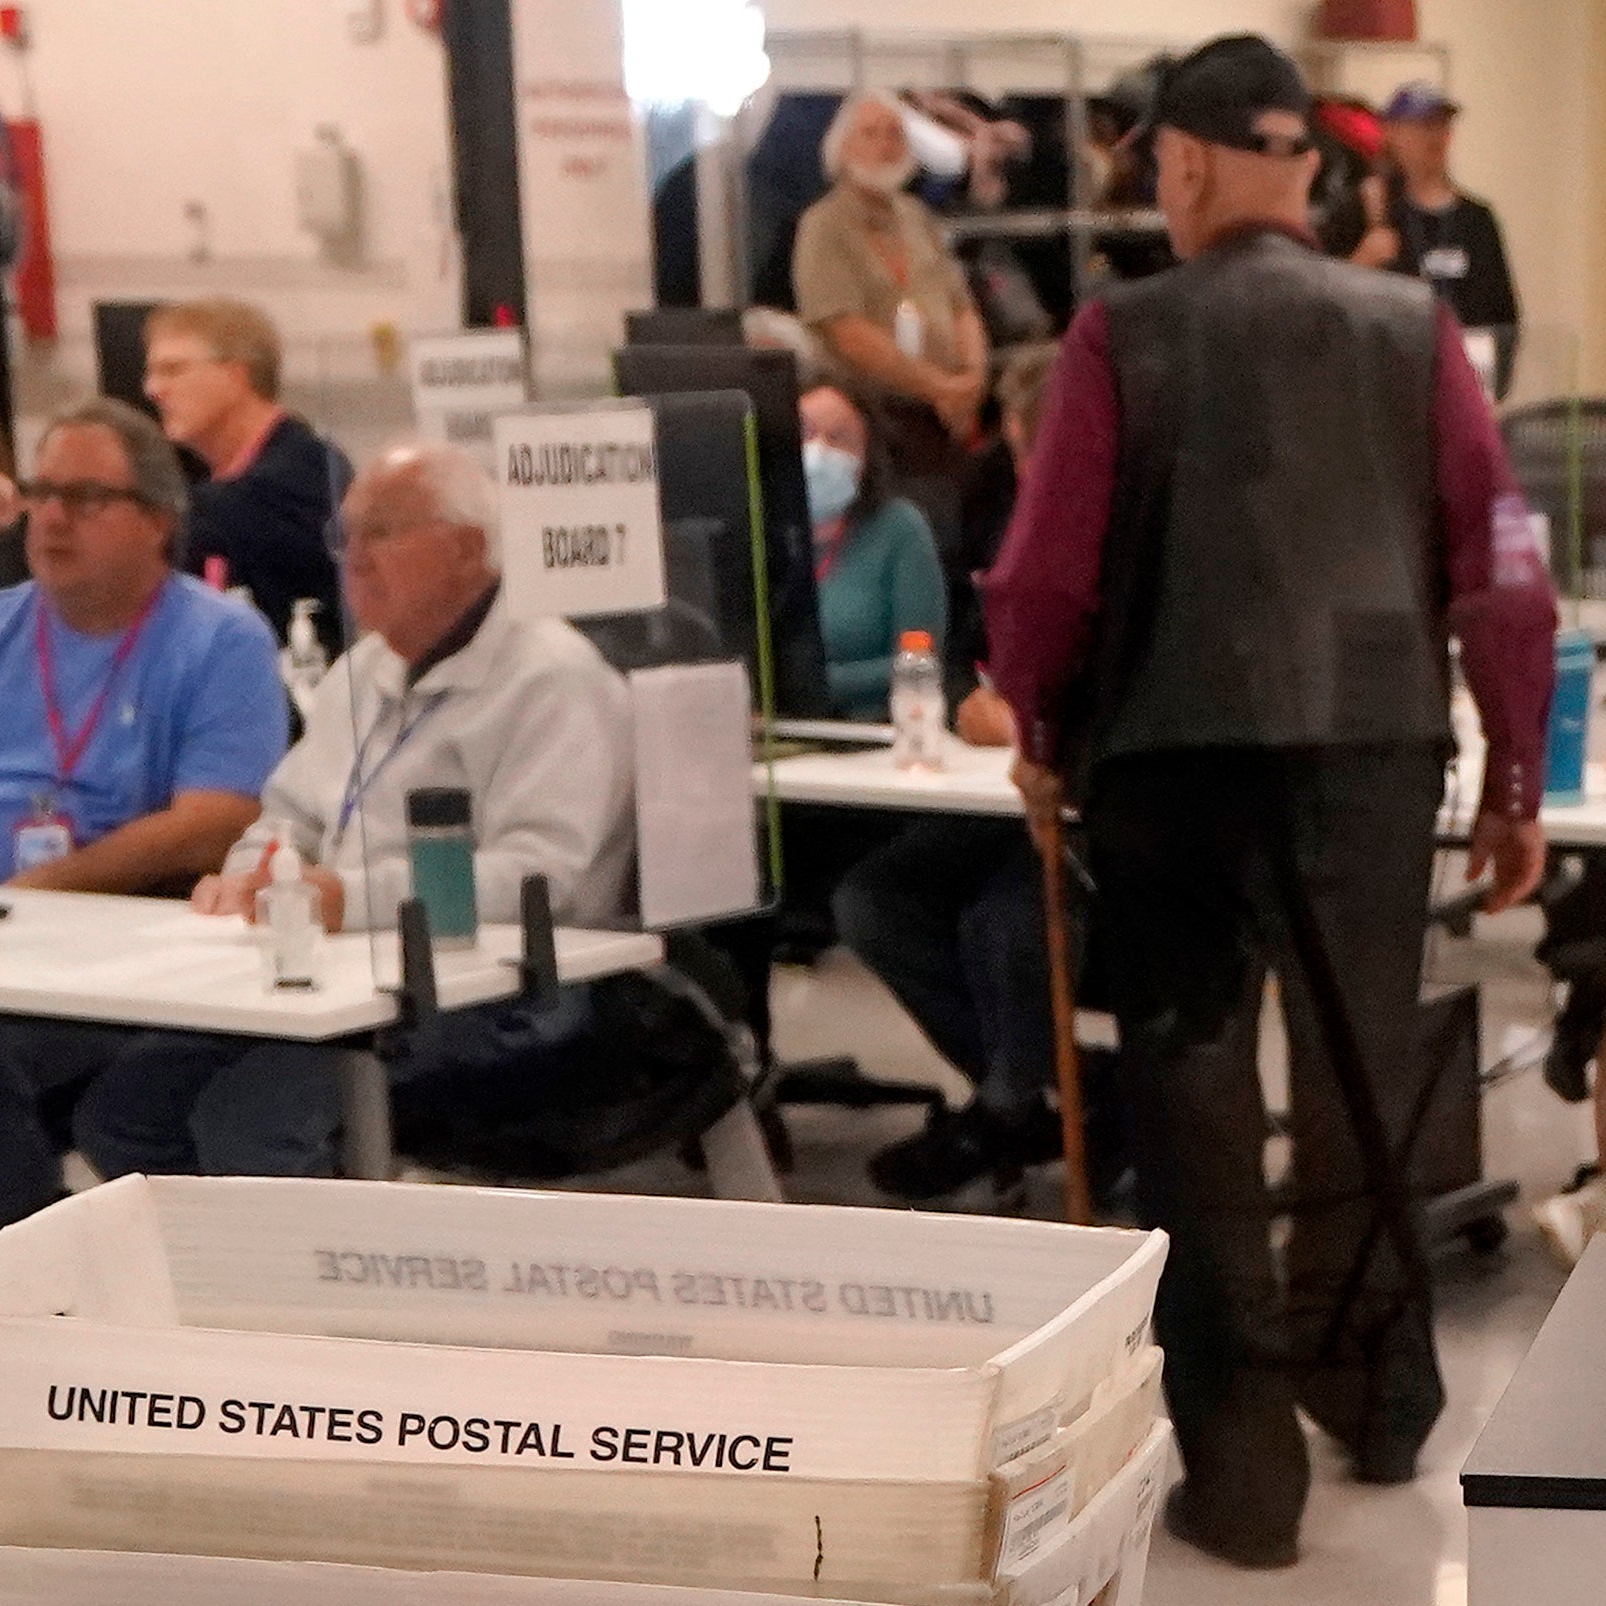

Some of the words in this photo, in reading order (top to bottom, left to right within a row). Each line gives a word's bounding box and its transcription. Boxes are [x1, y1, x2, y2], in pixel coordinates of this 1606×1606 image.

[542, 523, 610, 572] BOARD
[46, 1384, 206, 1431] UNITED
[218, 1399, 385, 1445] STATES
[397, 1412, 575, 1459] POSTAL
[590, 1424, 794, 1474] SERVICE
